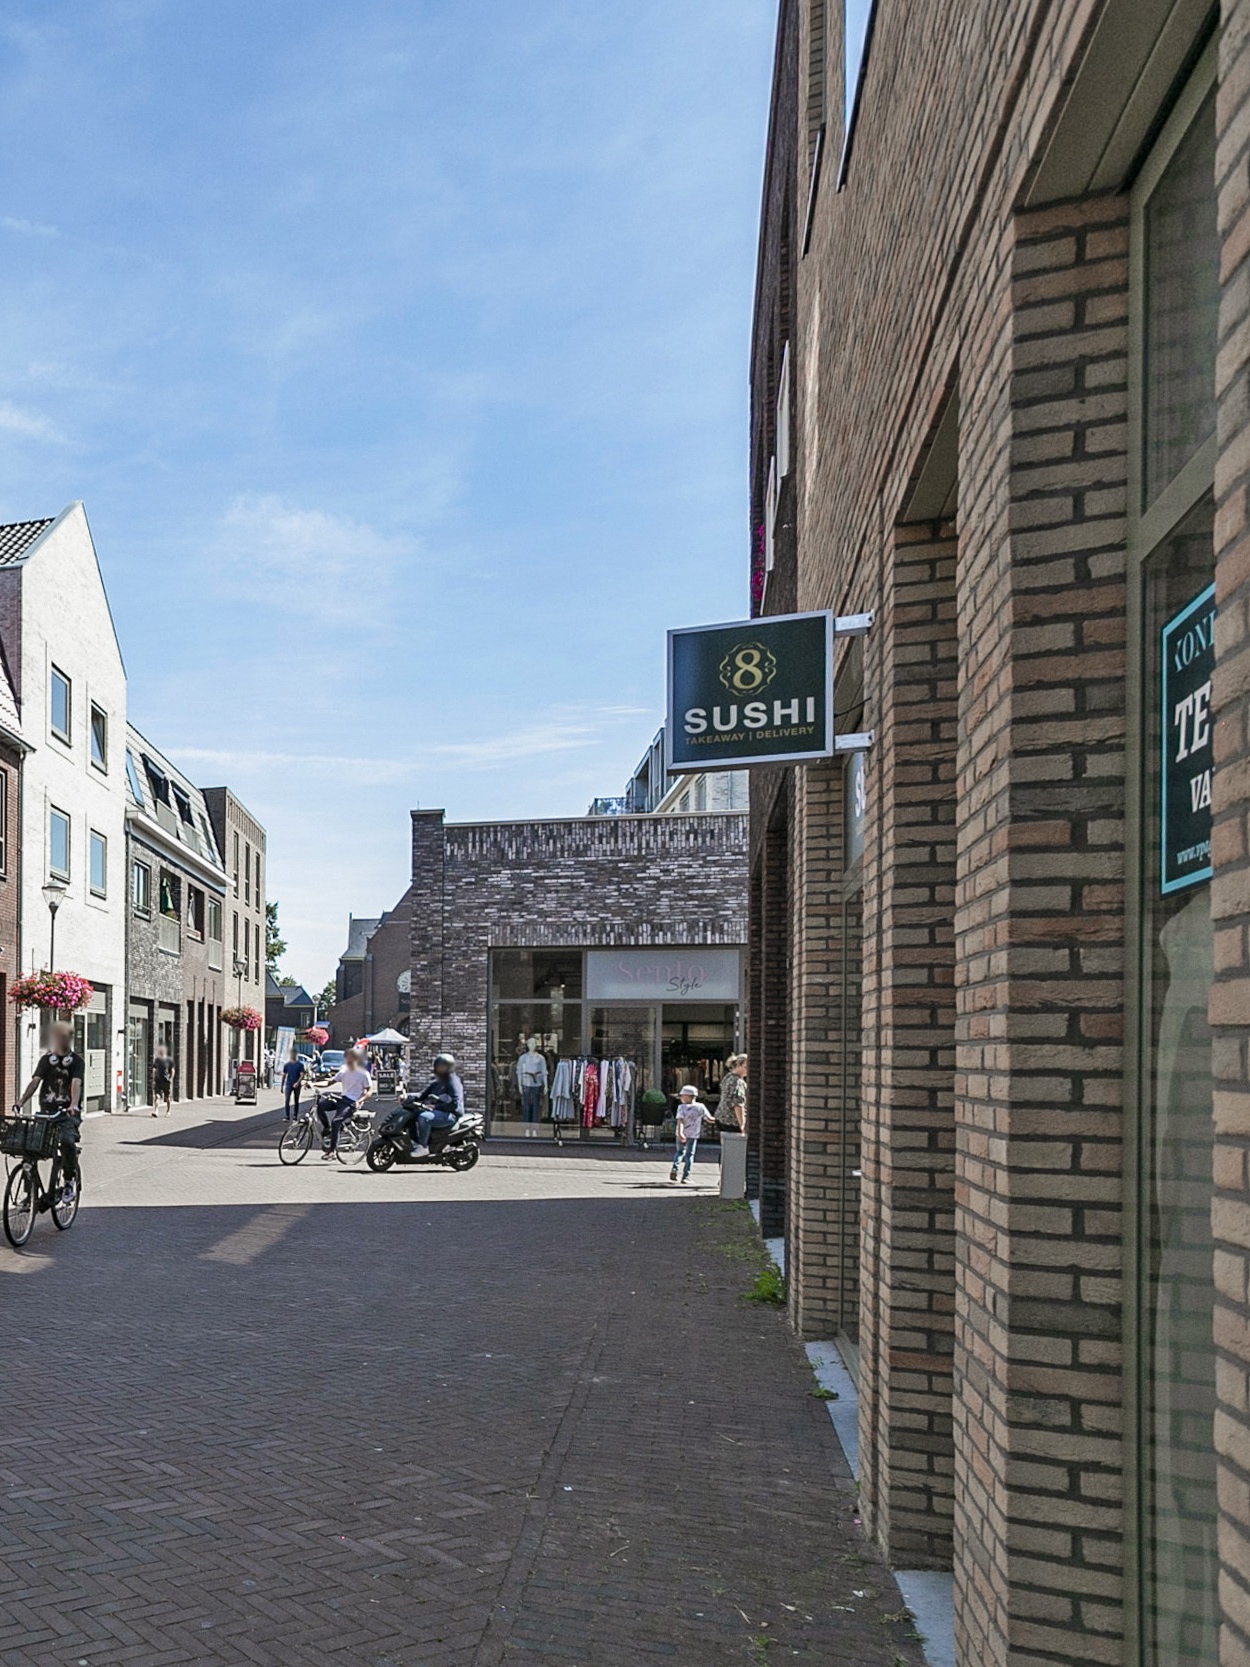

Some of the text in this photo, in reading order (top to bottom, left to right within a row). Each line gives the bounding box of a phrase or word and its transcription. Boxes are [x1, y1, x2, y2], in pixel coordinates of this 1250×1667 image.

[732, 649, 763, 690] 8
[683, 696, 815, 734] SUSHI
[1174, 680, 1212, 763] TE
[685, 726, 815, 745] TAKEAWAY DELIVERY
[1190, 766, 1216, 813] VA
[666, 976, 703, 996] Style
